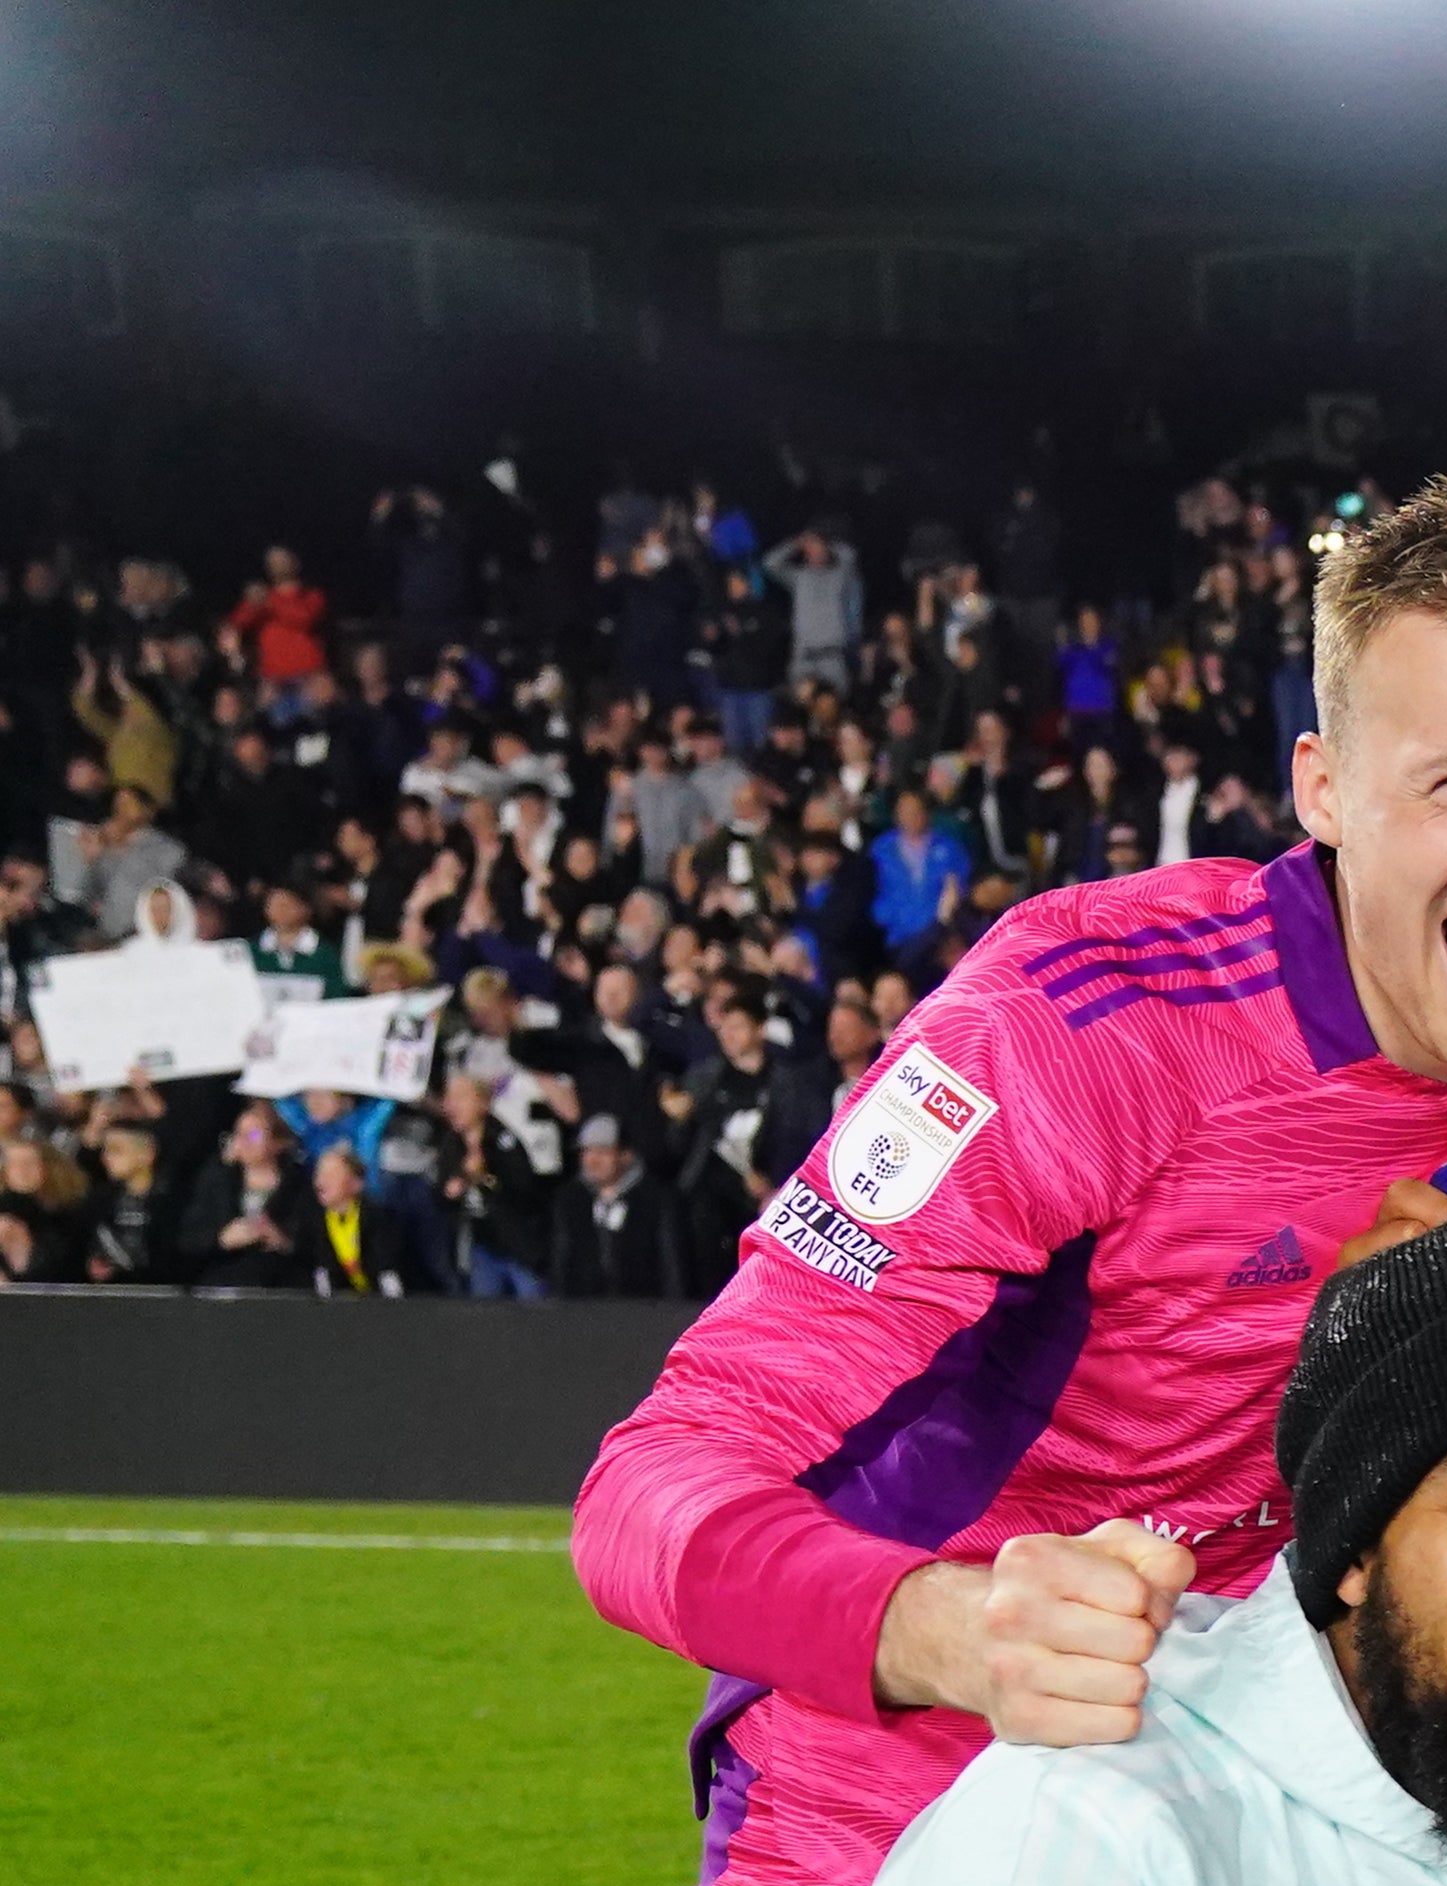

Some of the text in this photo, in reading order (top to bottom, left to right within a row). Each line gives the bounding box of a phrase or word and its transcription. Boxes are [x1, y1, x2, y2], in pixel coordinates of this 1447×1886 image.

[878, 1088, 954, 1149] CHAMPIONSHIP
[897, 1064, 969, 1127] sky bet
[850, 1172, 882, 1205] EFL
[779, 1177, 897, 1270] NOT TODAY
[784, 1228, 835, 1267] ANY
[829, 1254, 873, 1289] DAY
[1226, 1260, 1312, 1289] adidas
